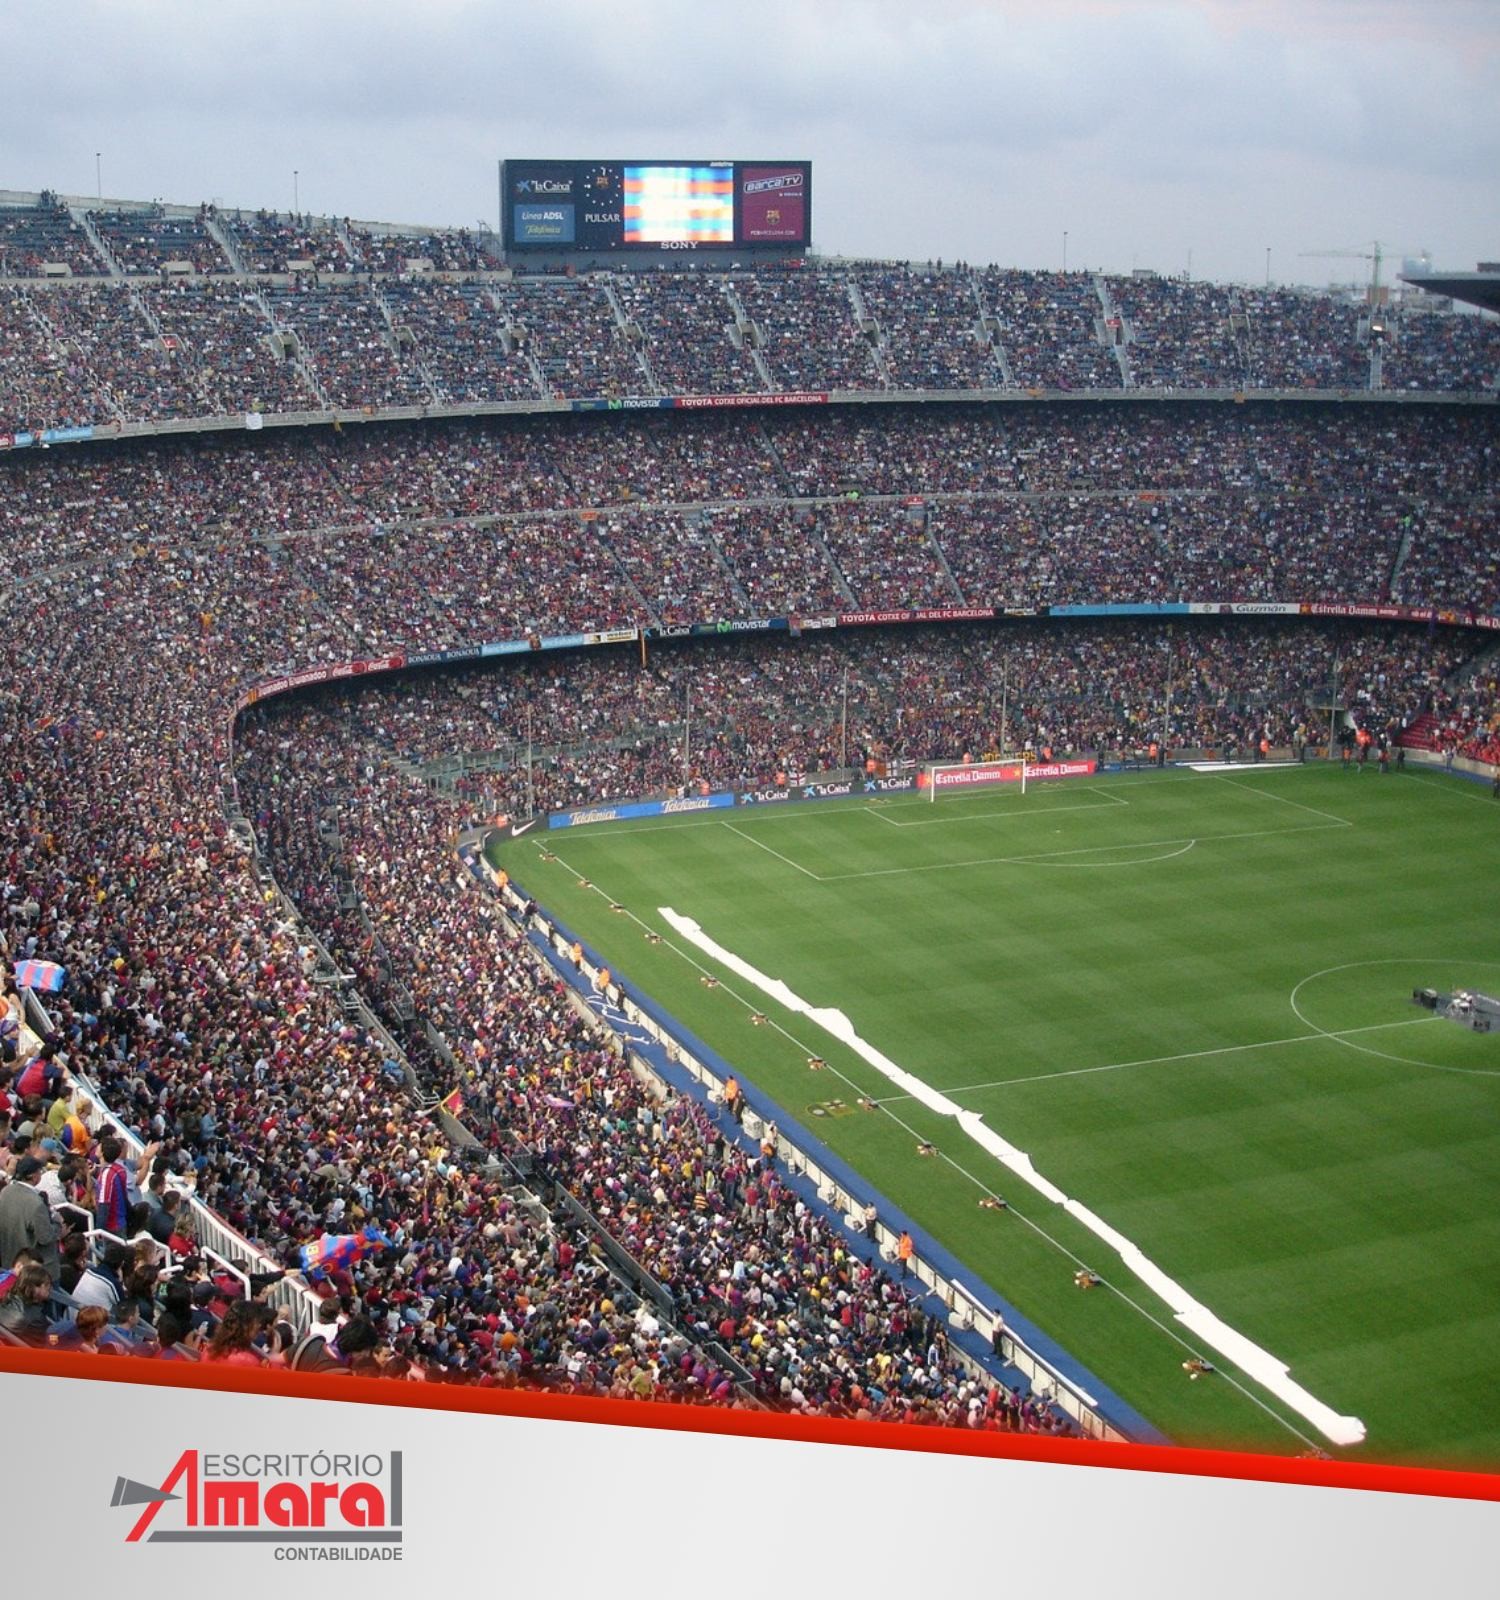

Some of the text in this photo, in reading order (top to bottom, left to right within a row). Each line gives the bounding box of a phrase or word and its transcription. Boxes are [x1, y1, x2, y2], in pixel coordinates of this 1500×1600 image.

[544, 212, 565, 220] ADSL
[585, 214, 620, 222] PULSAR
[661, 241, 698, 250] SONY
[682, 398, 713, 406] TOYOTA
[785, 395, 822, 403] BARCELONA
[842, 614, 875, 623] TOYOTA
[877, 613, 900, 621] COTXE
[928, 611, 941, 619] DEL
[953, 609, 993, 618] BARCELONA
[732, 619, 771, 631] movistar
[1025, 763, 1088, 778] Estrella Damm
[936, 770, 1001, 785] Estrella Damm
